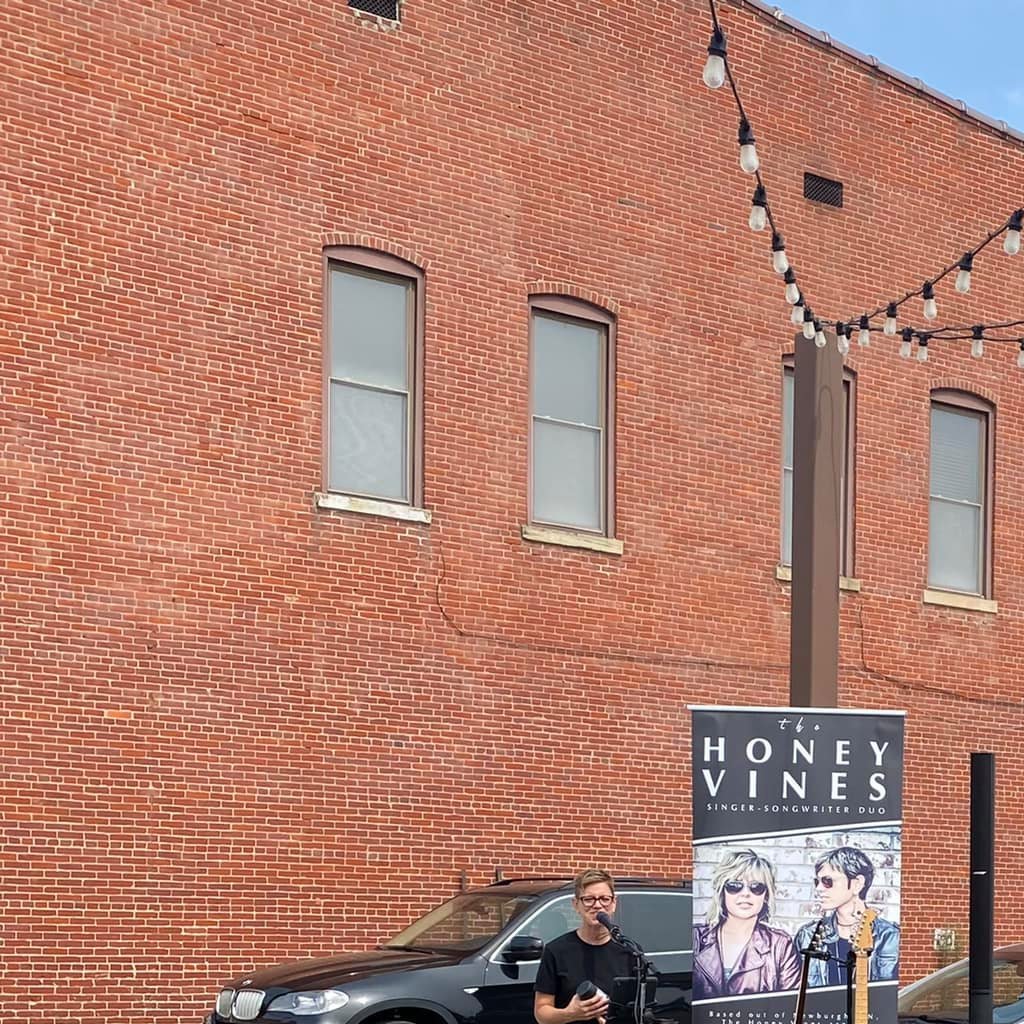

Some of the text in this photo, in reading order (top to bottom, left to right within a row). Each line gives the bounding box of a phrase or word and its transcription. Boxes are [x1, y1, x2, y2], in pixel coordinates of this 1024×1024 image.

[703, 736, 889, 766] HONEY
[702, 769, 887, 801] VINES
[707, 803, 886, 815] SINGER-SONGWRITER DUO
[709, 1010, 740, 1018] Based
